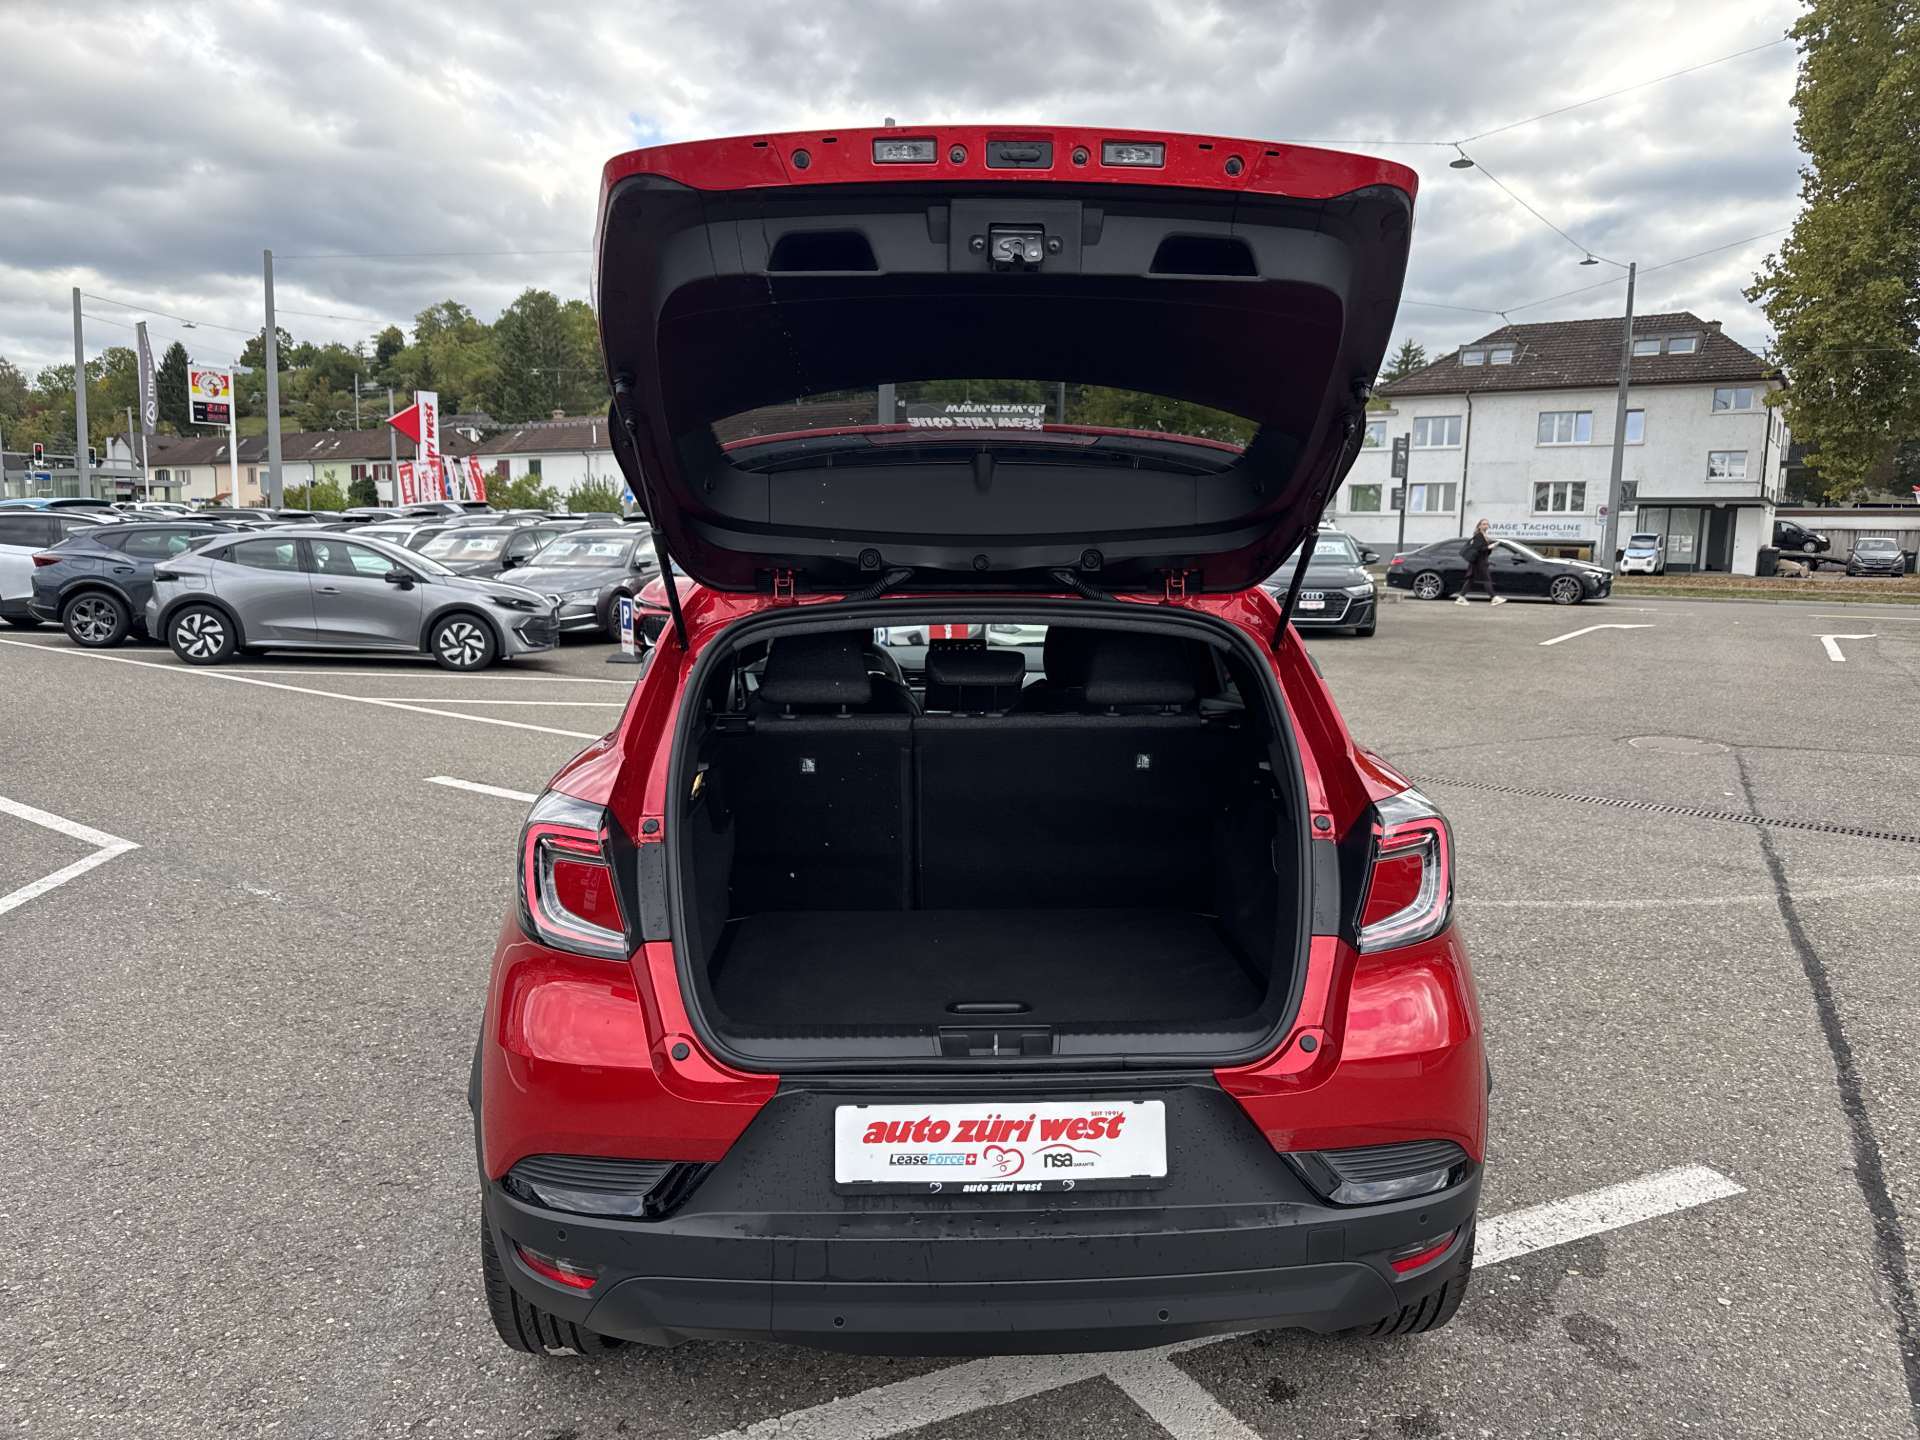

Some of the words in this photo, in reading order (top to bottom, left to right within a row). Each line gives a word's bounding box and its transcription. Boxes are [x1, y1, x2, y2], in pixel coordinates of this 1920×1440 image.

[424, 401, 435, 438] west
[623, 605, 630, 625] P
[863, 1115, 951, 1144] auto
[951, 1113, 1036, 1143] züri
[1040, 1111, 1126, 1141] west
[889, 1153, 965, 1166] LeaseForce
[1044, 1153, 1073, 1168] nsa
[962, 1183, 988, 1192] auto
[990, 1182, 1014, 1192] züri
[1016, 1182, 1042, 1191] west
